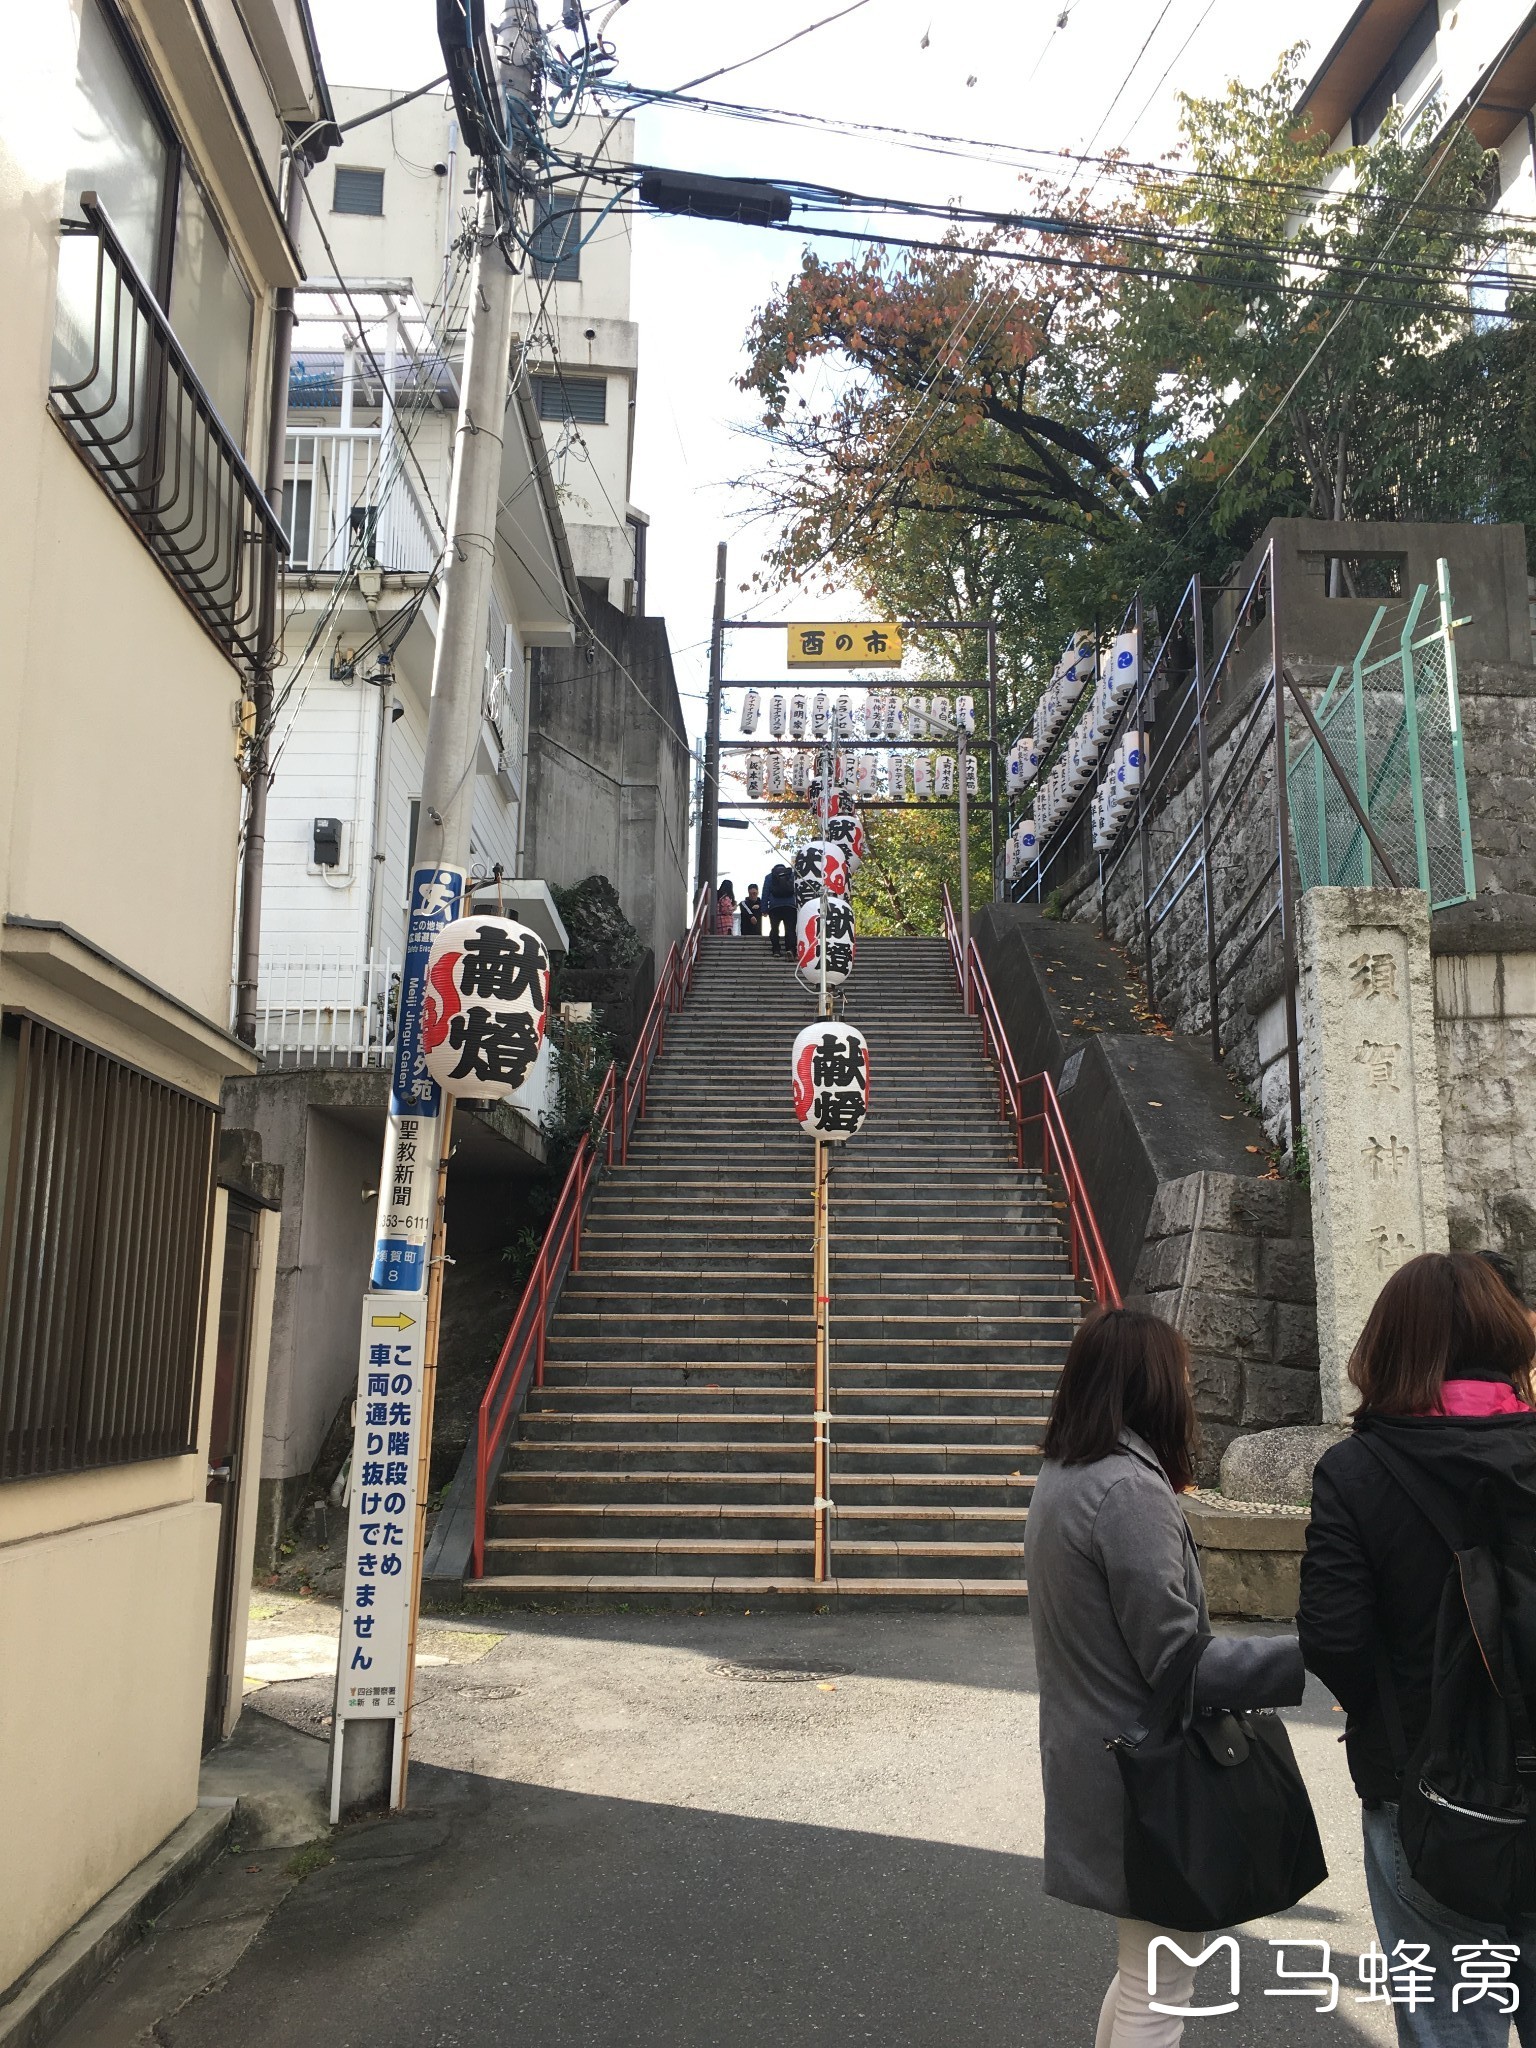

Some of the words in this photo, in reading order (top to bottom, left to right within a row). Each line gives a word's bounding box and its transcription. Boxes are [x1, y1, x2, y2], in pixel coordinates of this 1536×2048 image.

[800, 629, 889, 655] 酉の市
[793, 700, 806, 729] 有明家
[844, 757, 856, 786] コメット
[941, 758, 952, 790] 上野材木店
[405, 977, 420, 1008] Meiji
[448, 925, 549, 1090] 献燈
[401, 1010, 416, 1047] Jingu
[398, 1052, 411, 1089] Gaien
[813, 1033, 867, 1133] 献燈
[1348, 953, 1416, 1272] 須賀神社
[392, 1120, 419, 1207] 聖教新聞
[377, 1250, 417, 1264] 須賀町
[388, 1270, 399, 1282] 8
[380, 1344, 413, 1576] この先階段のため
[350, 1344, 392, 1672] 車両通り抜けできません
[357, 1686, 396, 1696] 四谷警察署
[357, 1697, 396, 1707] 新宿区
